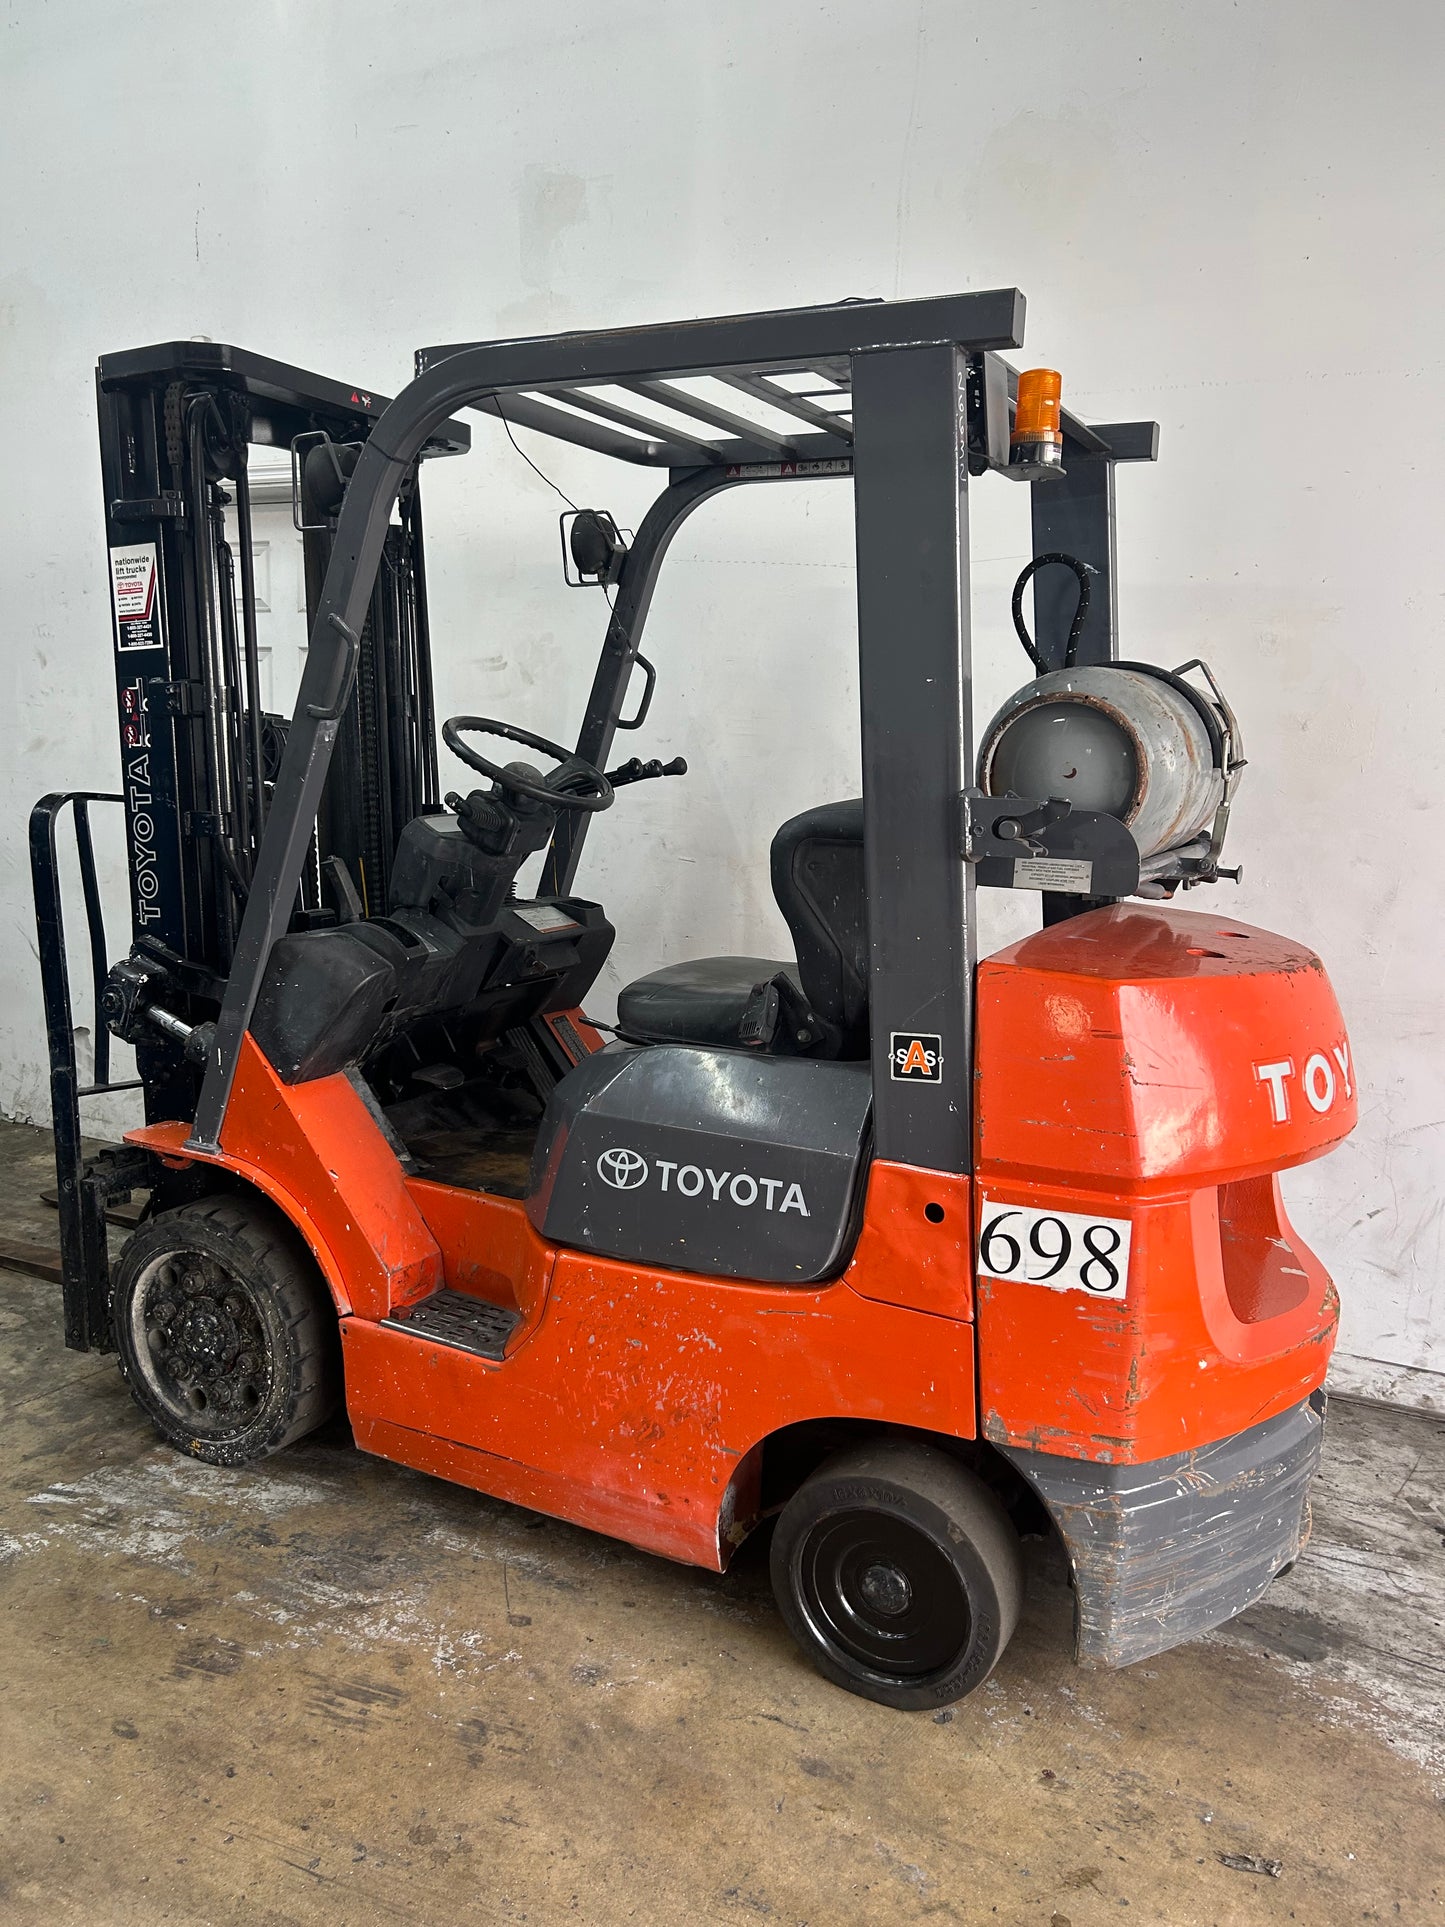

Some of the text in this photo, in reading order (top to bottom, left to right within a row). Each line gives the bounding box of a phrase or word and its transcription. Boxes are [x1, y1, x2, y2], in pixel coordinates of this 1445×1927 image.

[114, 556, 149, 566] nationwide
[126, 565, 146, 574] trucks
[128, 753, 161, 925] TOYOTA
[896, 1040, 937, 1075] SAS
[655, 1159, 809, 1217] TOYOTA
[980, 1211, 1121, 1292] 698
